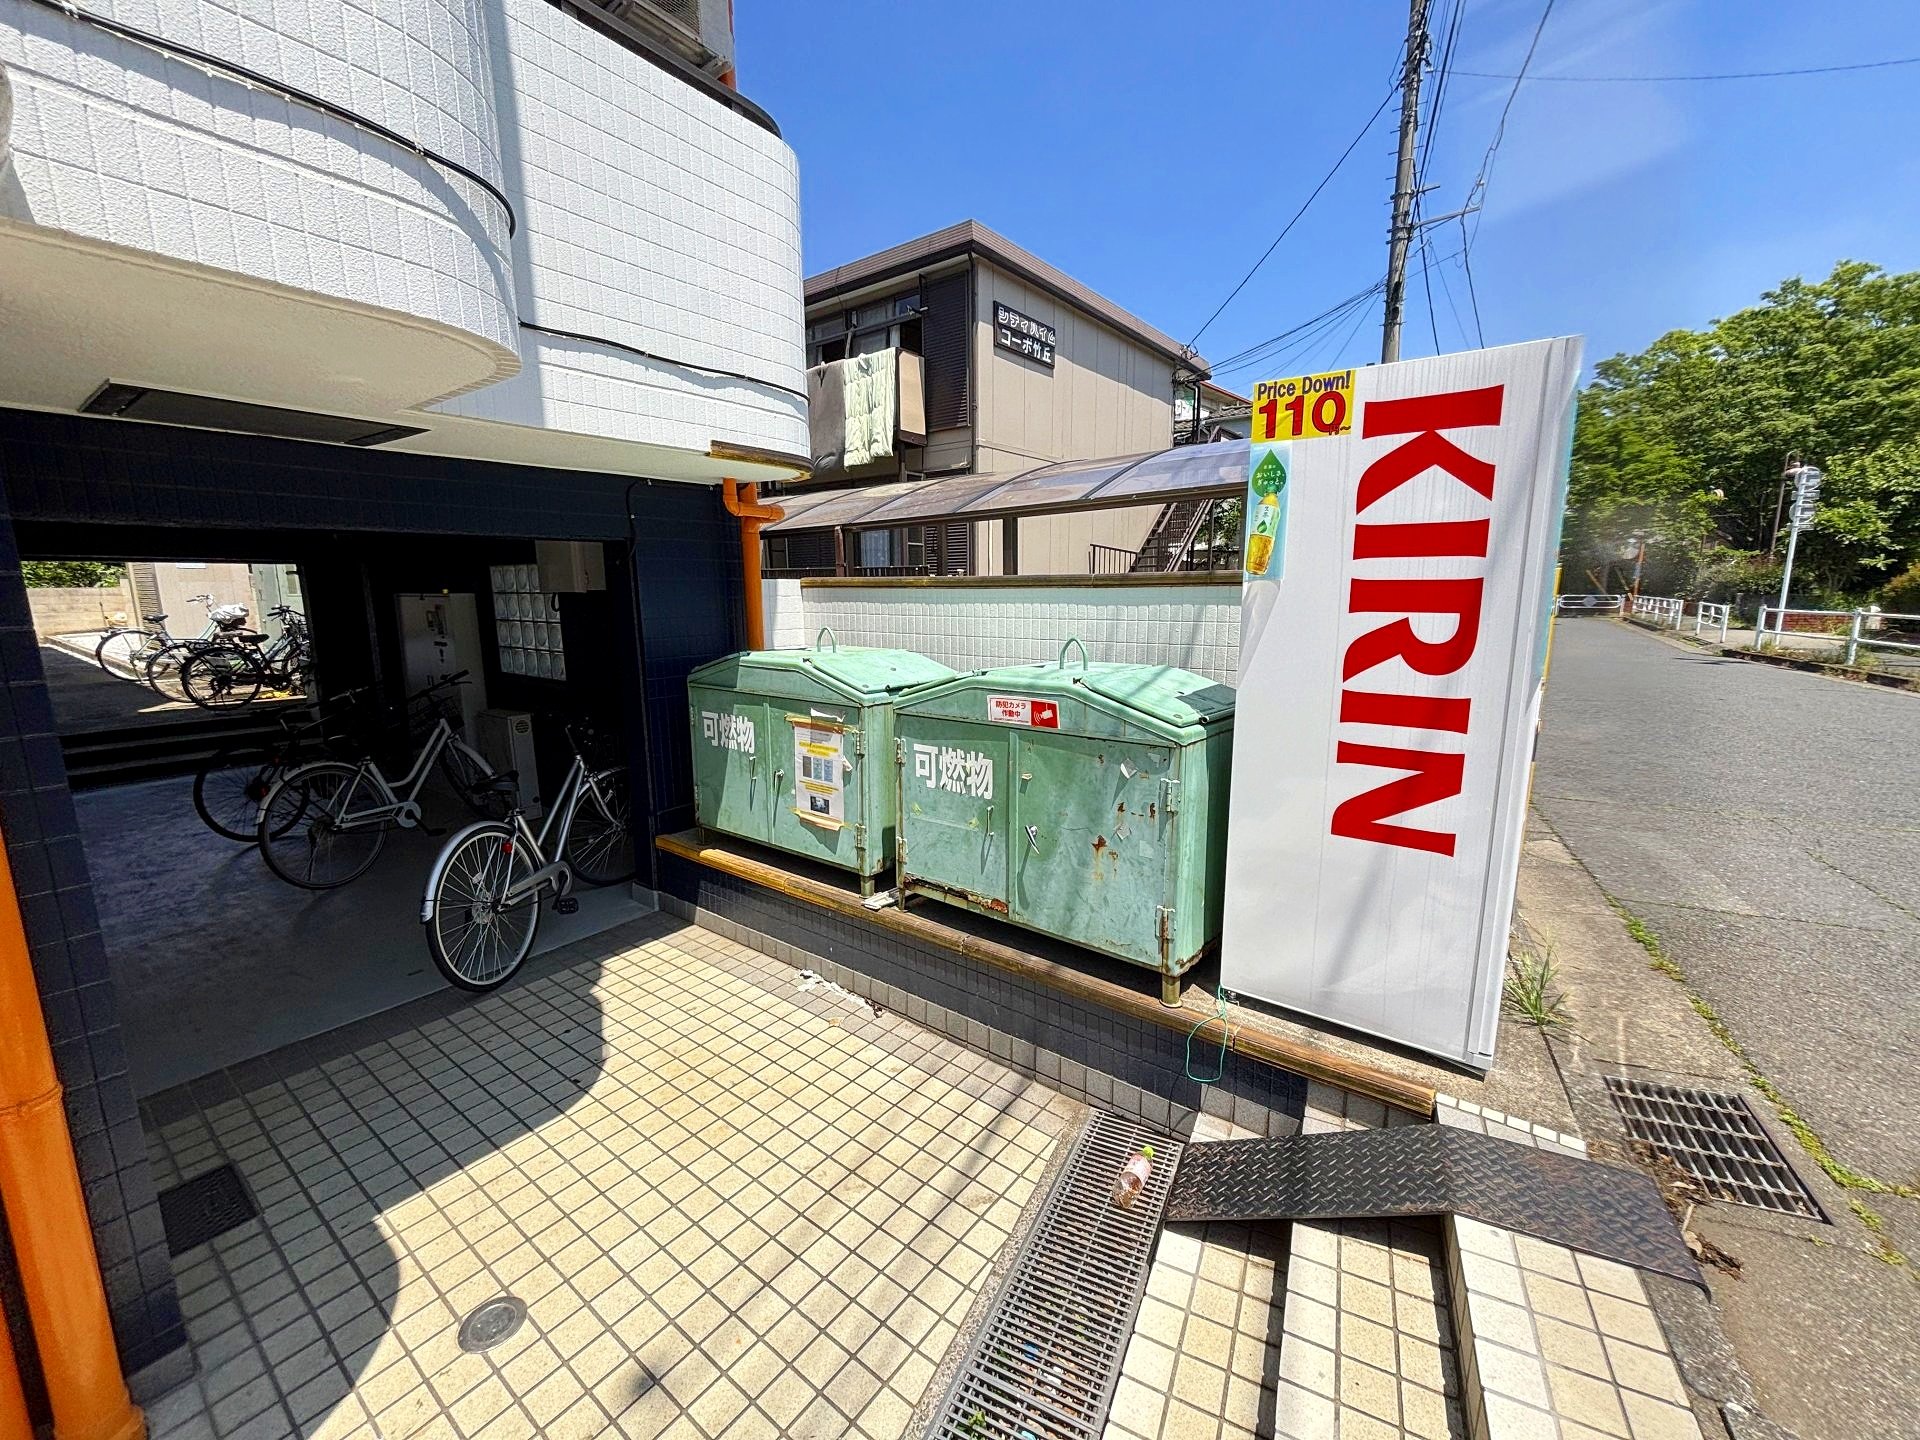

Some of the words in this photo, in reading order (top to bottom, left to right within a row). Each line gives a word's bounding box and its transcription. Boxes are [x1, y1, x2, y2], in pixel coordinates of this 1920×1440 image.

[1258, 381, 1296, 401] Price
[1302, 370, 1351, 395] Down!
[1331, 384, 1504, 858] KIRIN
[995, 700, 1026, 710] 防犯カメラ
[1002, 709, 1021, 718] 作動中
[701, 710, 755, 754] 可燃物
[913, 743, 994, 800] 可燃物
